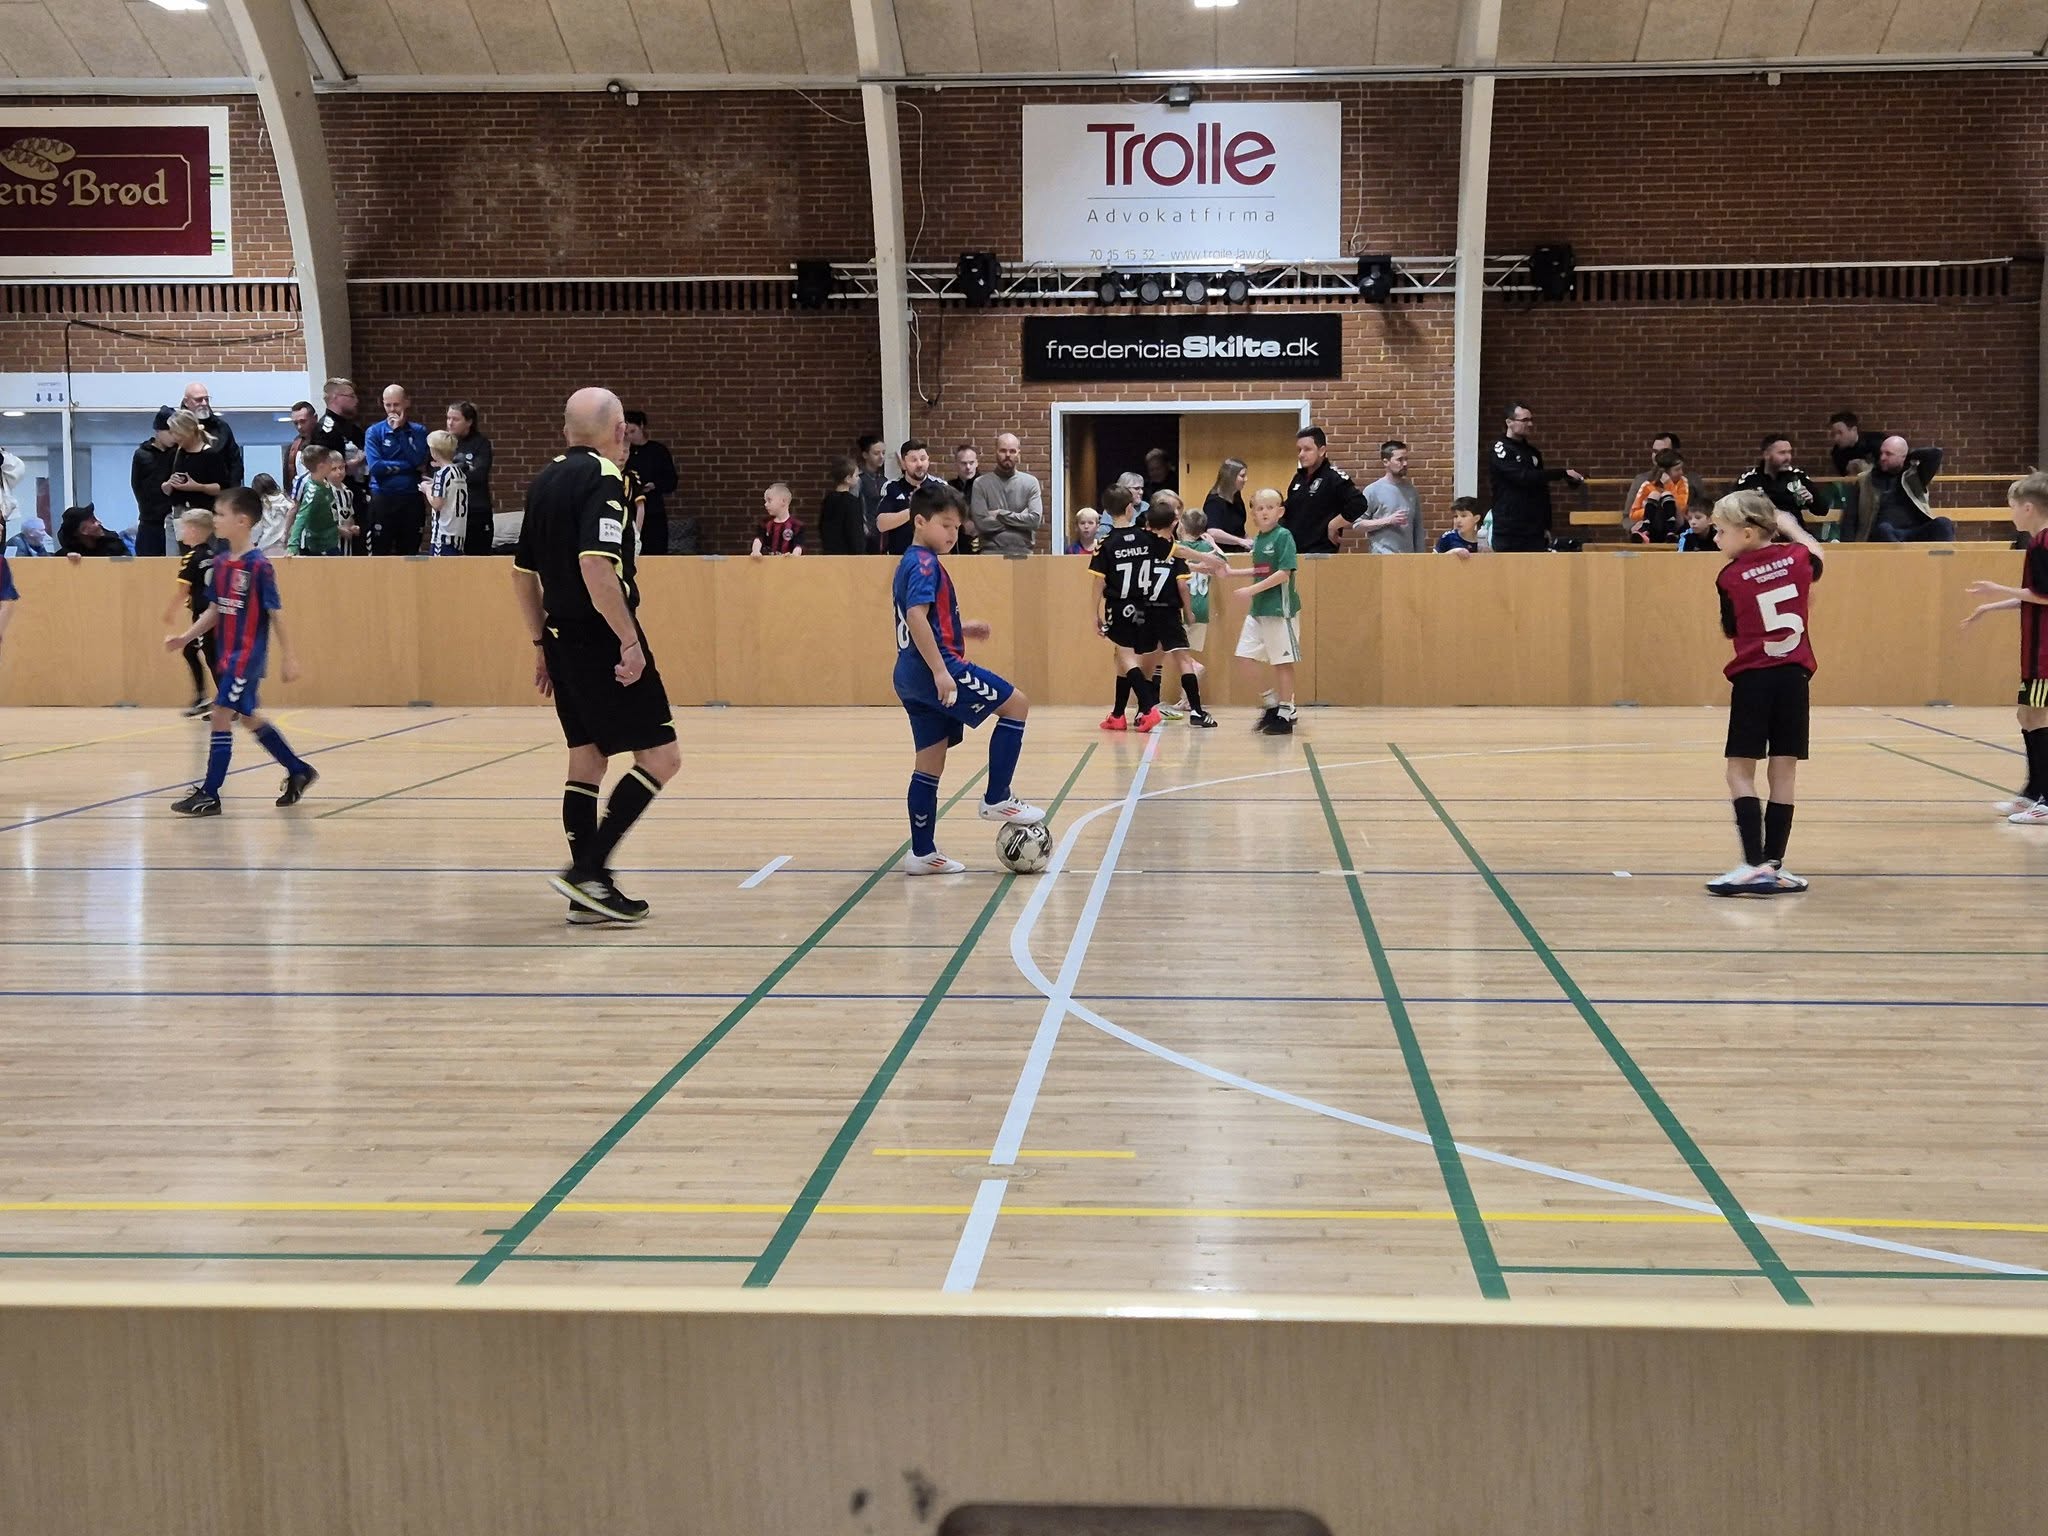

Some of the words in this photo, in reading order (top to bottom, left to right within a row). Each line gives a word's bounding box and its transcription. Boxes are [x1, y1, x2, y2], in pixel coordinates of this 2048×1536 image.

[1087, 122, 1277, 187] Trolle
[62, 168, 169, 206] Brød
[1086, 207, 1276, 224] Advokatfirma
[1089, 249, 1103, 261] 70
[1106, 249, 1119, 261] 15
[1124, 249, 1137, 261] 15
[1142, 249, 1155, 261] 32
[1045, 335, 1320, 359] fredericiaSkilte.dk
[455, 487, 468, 518] 13
[1149, 566, 1171, 602] 7
[1755, 583, 1805, 658] 5
